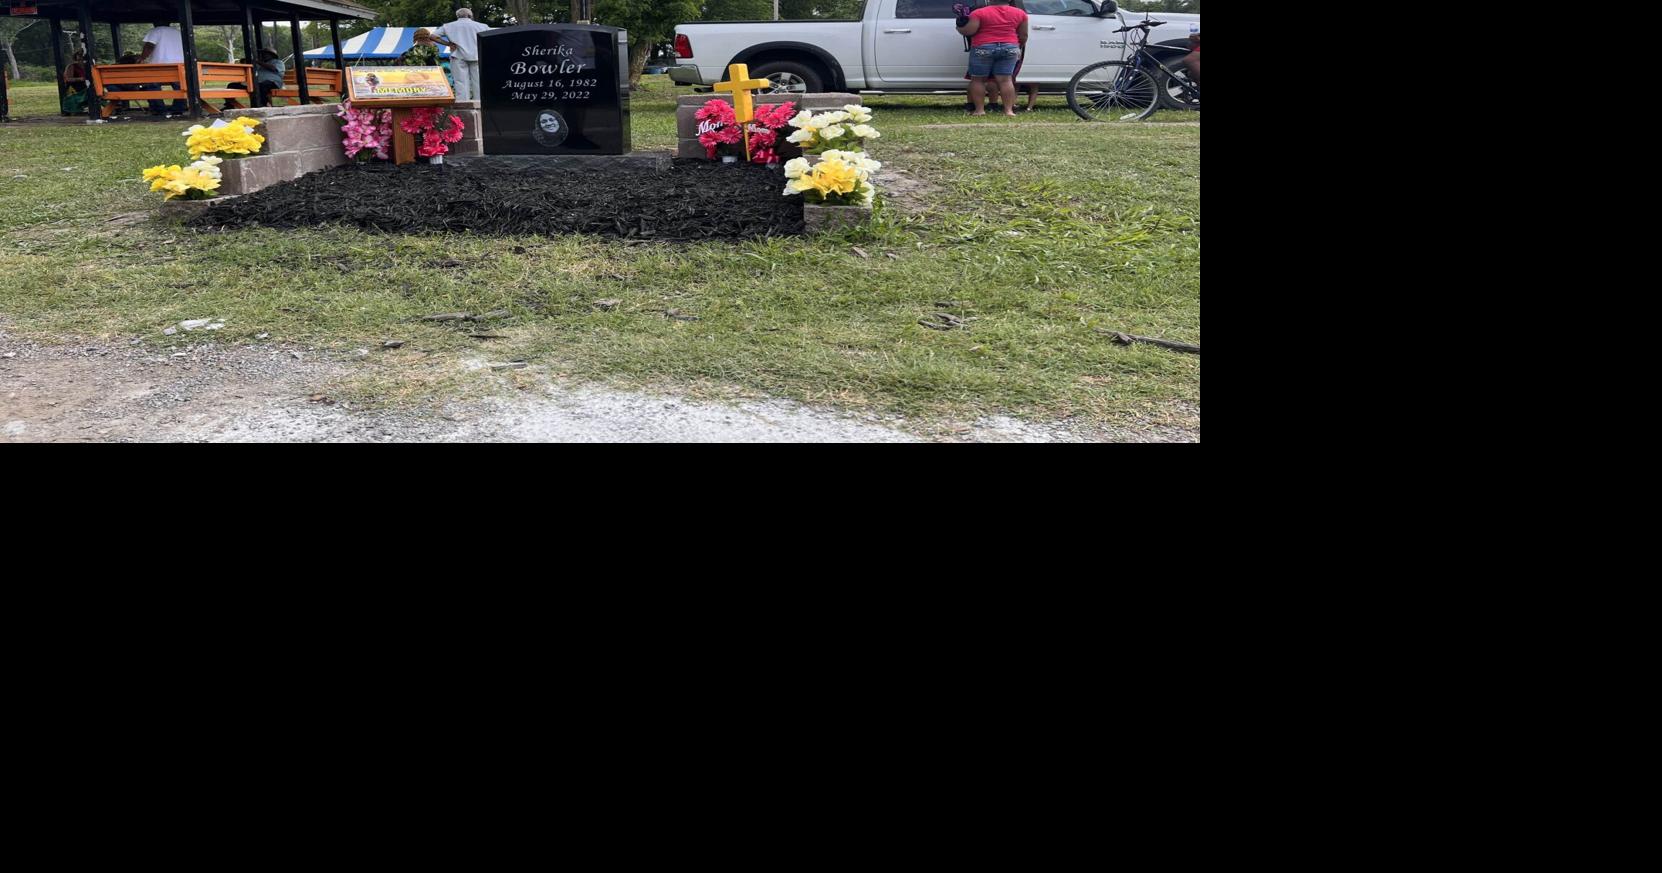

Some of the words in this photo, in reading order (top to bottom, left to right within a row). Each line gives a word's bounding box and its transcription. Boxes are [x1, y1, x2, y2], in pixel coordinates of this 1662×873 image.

[521, 44, 574, 57] Sherika
[510, 59, 587, 75] Bowler
[501, 79, 544, 90] August
[548, 79, 565, 88] 16,
[570, 79, 598, 87] 1982
[511, 91, 538, 102] May
[541, 91, 558, 100] 29,
[561, 91, 591, 99] 2022
